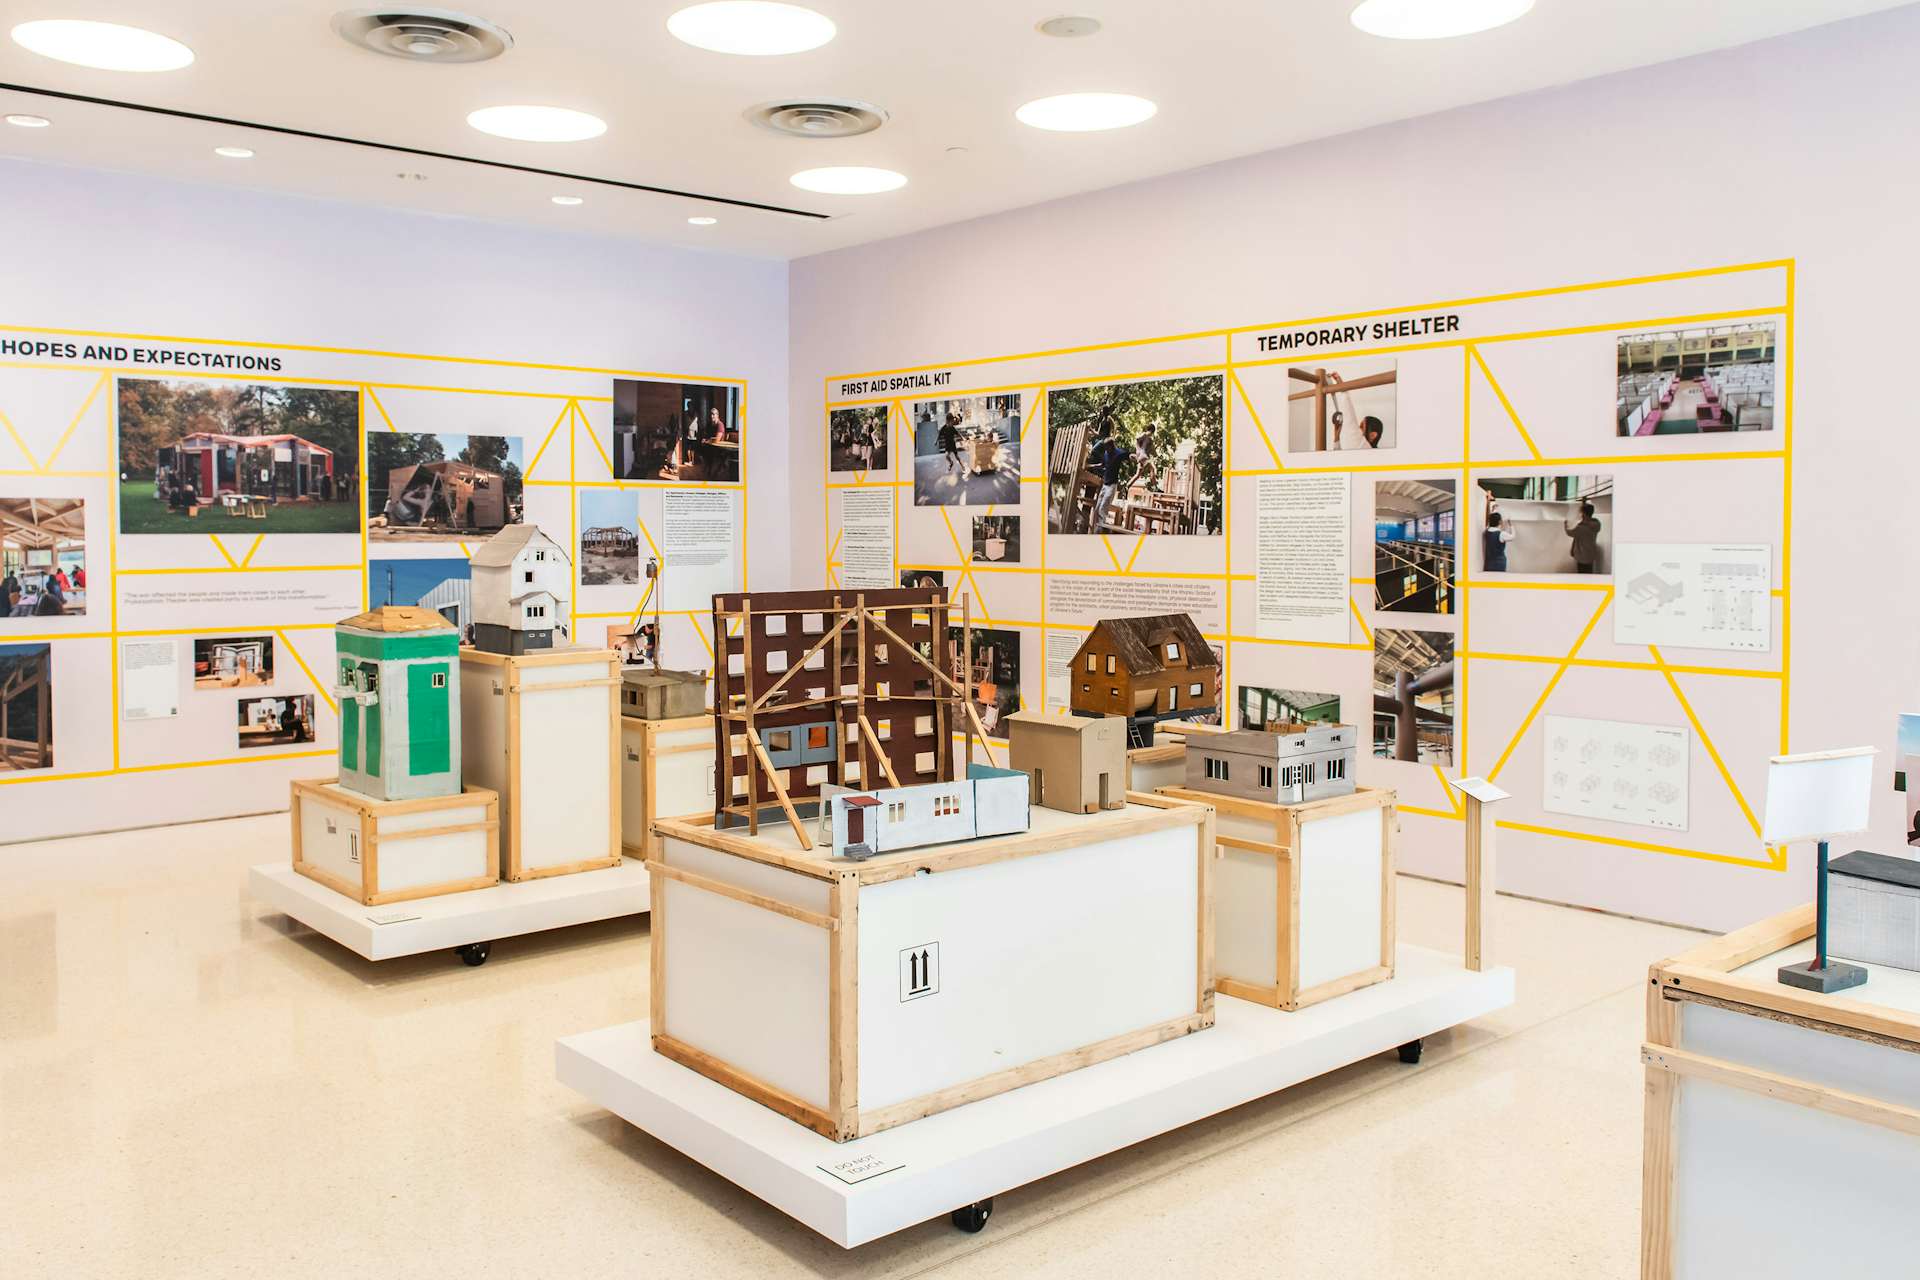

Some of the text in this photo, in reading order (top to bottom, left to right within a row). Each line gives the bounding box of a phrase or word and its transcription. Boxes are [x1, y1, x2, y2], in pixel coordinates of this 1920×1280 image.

[1258, 315, 1460, 352] TEMPORARY SHELTER
[1, 339, 282, 371] HOPES AND EXPECTATIONS
[841, 371, 952, 396] FIRST AID SPATIAL KIT
[835, 1153, 875, 1171] DO NOT
[847, 1160, 885, 1175] TOUCH
